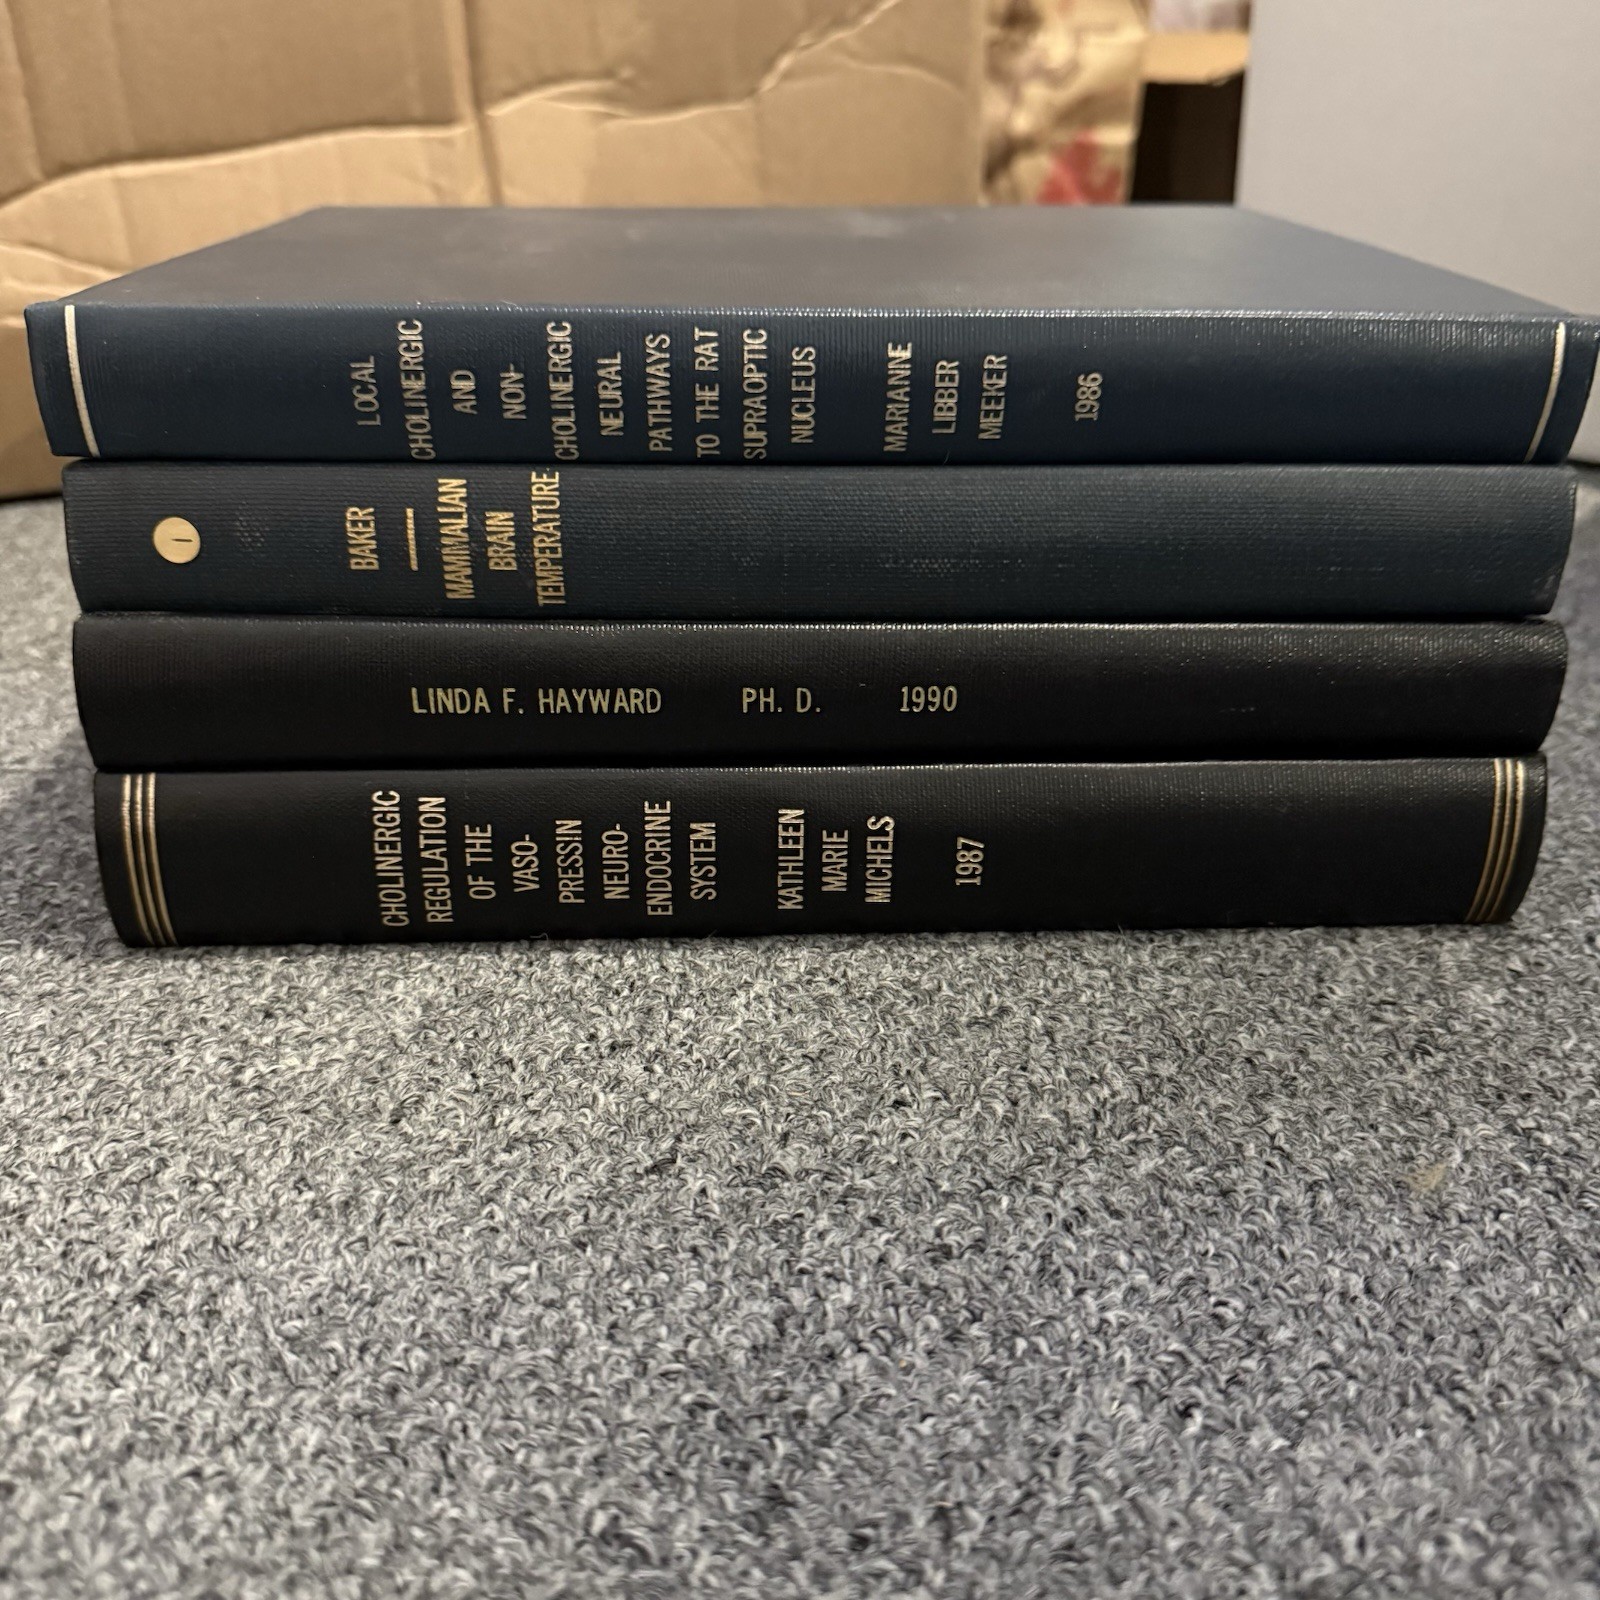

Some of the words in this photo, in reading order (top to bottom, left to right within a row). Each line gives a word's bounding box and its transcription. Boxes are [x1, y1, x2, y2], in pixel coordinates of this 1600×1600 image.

[694, 327, 719, 371] RAT
[350, 356, 381, 426] LOCAL
[398, 319, 436, 461] CHOLINERGIC
[450, 369, 478, 414] AND
[500, 363, 527, 420] NON-
[547, 321, 579, 461] CHOLINERGIC
[597, 352, 624, 436] NEURAL
[646, 334, 672, 452] PATHWAYS
[696, 382, 720, 422] THE
[743, 329, 768, 460] SUPRAOPTIC
[791, 347, 816, 444] NUCLEUS
[883, 342, 912, 452] MARIANNE
[932, 360, 959, 434] LIBBER
[978, 355, 1007, 440] MEEKER
[1075, 372, 1102, 421] 1986
[697, 433, 721, 458] TO
[345, 506, 379, 571] BAKER
[438, 478, 475, 599] MAMMALIAN
[485, 511, 518, 571] BRAIN
[411, 687, 491, 714] LINDA
[503, 688, 524, 714] F.
[538, 687, 662, 714] HAYWARD
[742, 687, 782, 713] PH.
[796, 687, 821, 713] D.
[900, 686, 958, 712] 1990
[371, 790, 410, 926] CHOLINERGIC
[418, 797, 454, 923] REGULATION
[465, 823, 492, 866] THE
[511, 834, 540, 893] VASO-
[555, 820, 585, 903] PRESSIN
[601, 823, 630, 899] NEURO-
[644, 800, 673, 916] ENDOCRINE
[690, 822, 717, 900] SYSTEM
[778, 809, 805, 910] KATHLEEN
[822, 829, 849, 892] MARIE
[865, 815, 895, 903] MICHELS
[955, 836, 985, 886] 1987
[468, 874, 496, 900] OF
